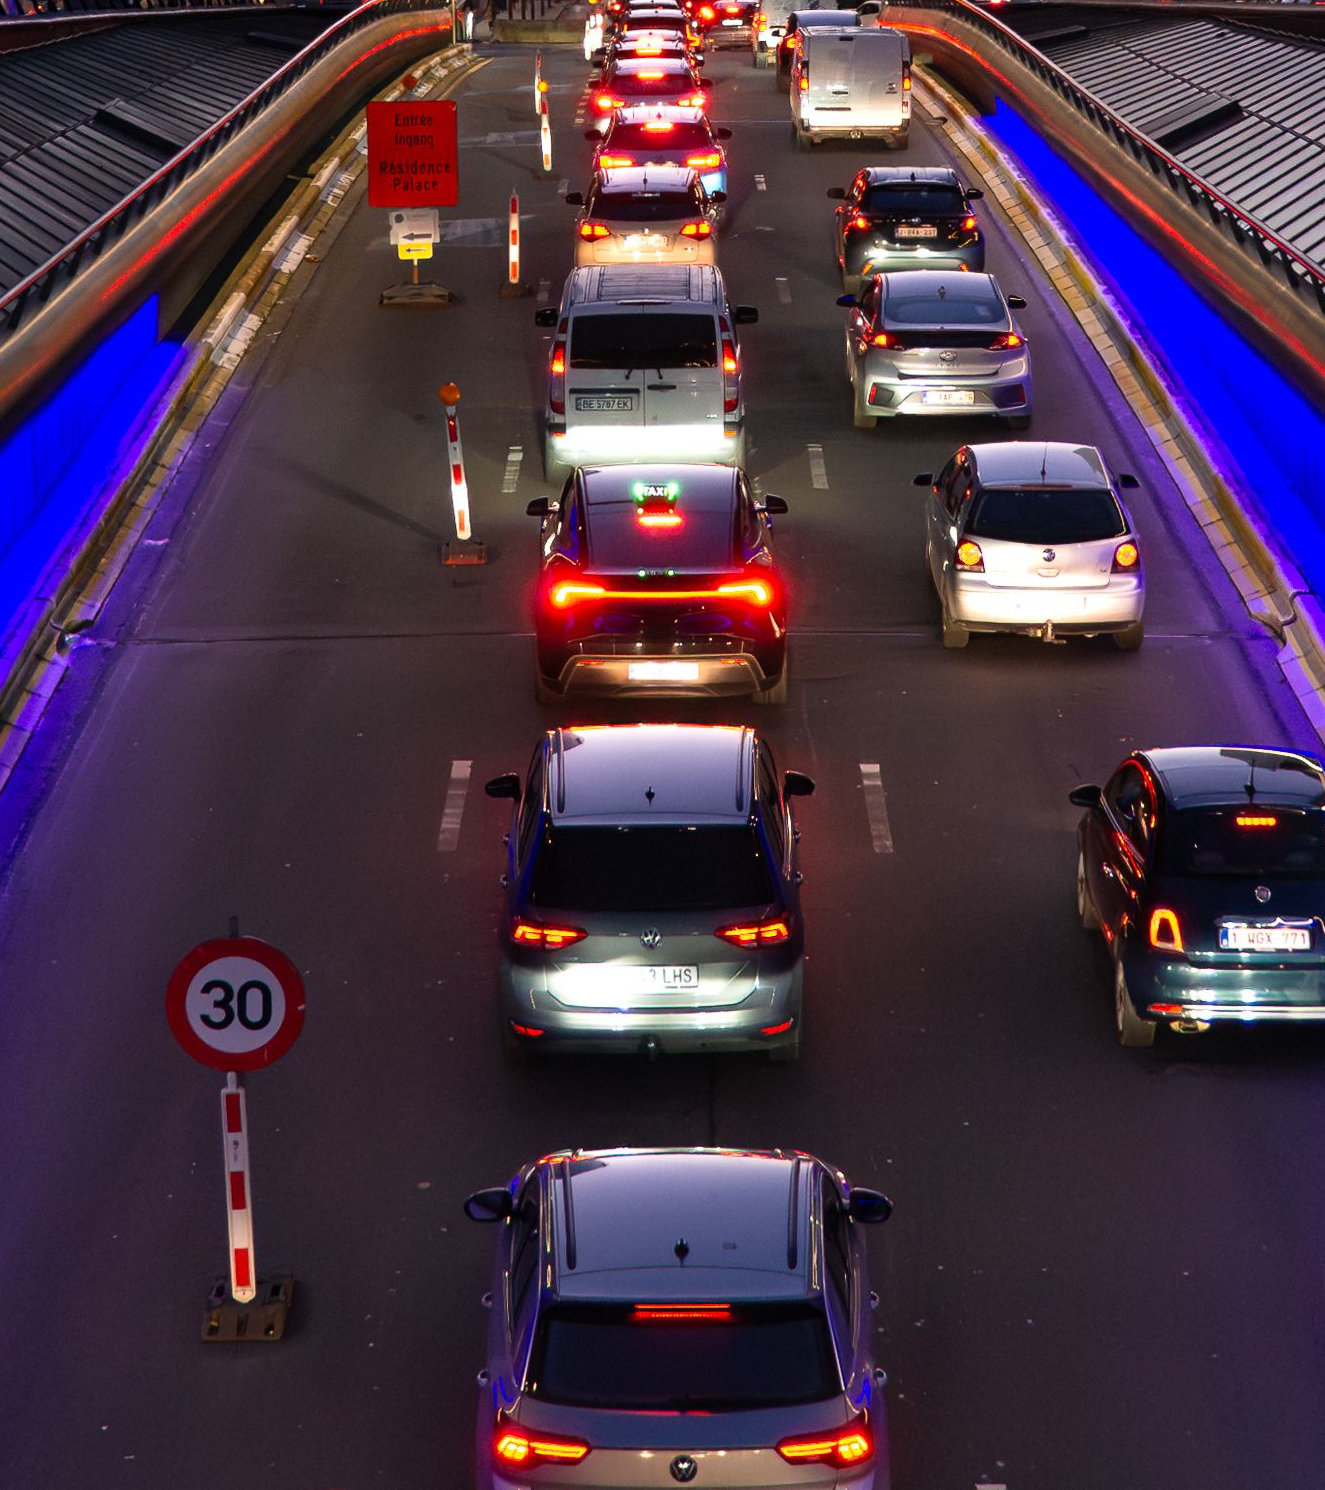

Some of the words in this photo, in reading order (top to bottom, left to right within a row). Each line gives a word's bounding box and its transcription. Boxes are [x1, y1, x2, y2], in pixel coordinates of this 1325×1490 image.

[394, 113, 433, 127] Entrée
[393, 178, 438, 192] Palace
[643, 486, 668, 497] TAXI
[663, 968, 692, 984] LHS
[199, 979, 273, 1031] 30
